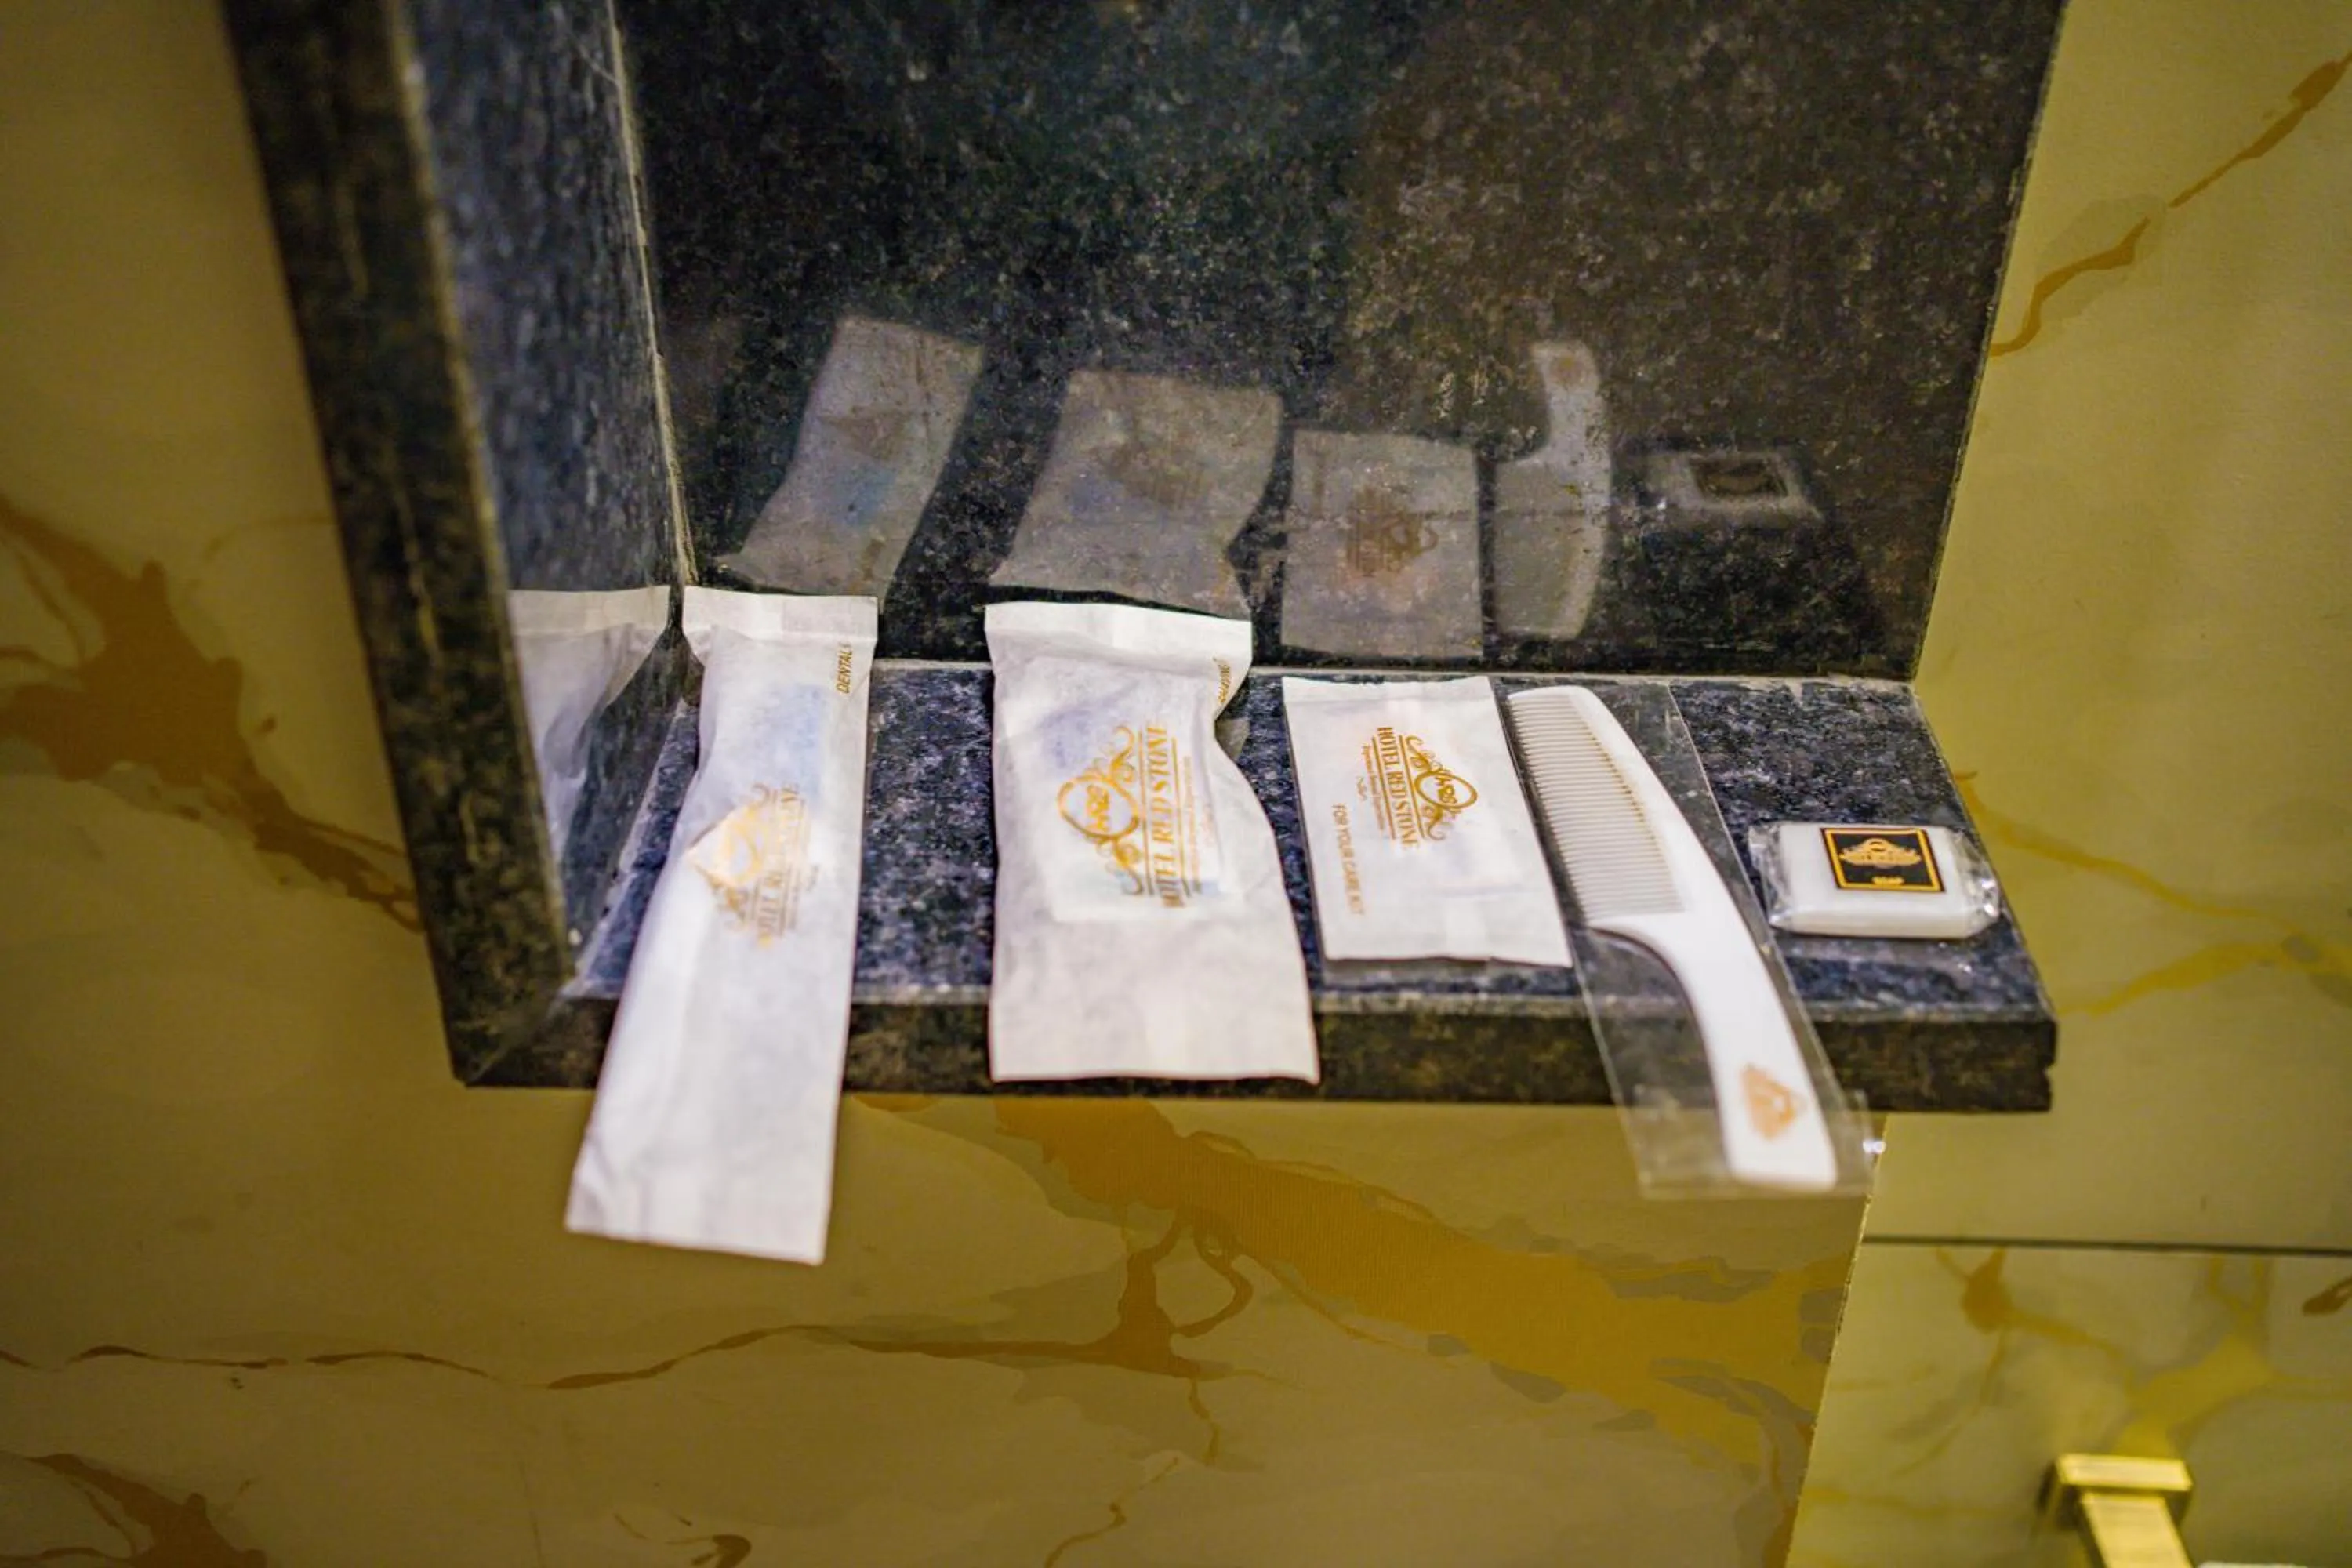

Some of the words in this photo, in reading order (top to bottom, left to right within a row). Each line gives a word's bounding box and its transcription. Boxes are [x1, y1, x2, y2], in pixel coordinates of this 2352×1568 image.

[1377, 727, 1400, 770] HOTEL
[1387, 771, 1409, 800] RED
[1152, 797, 1174, 844] RED
[1332, 804, 1351, 826] FOR
[1394, 801, 1418, 848] STONE
